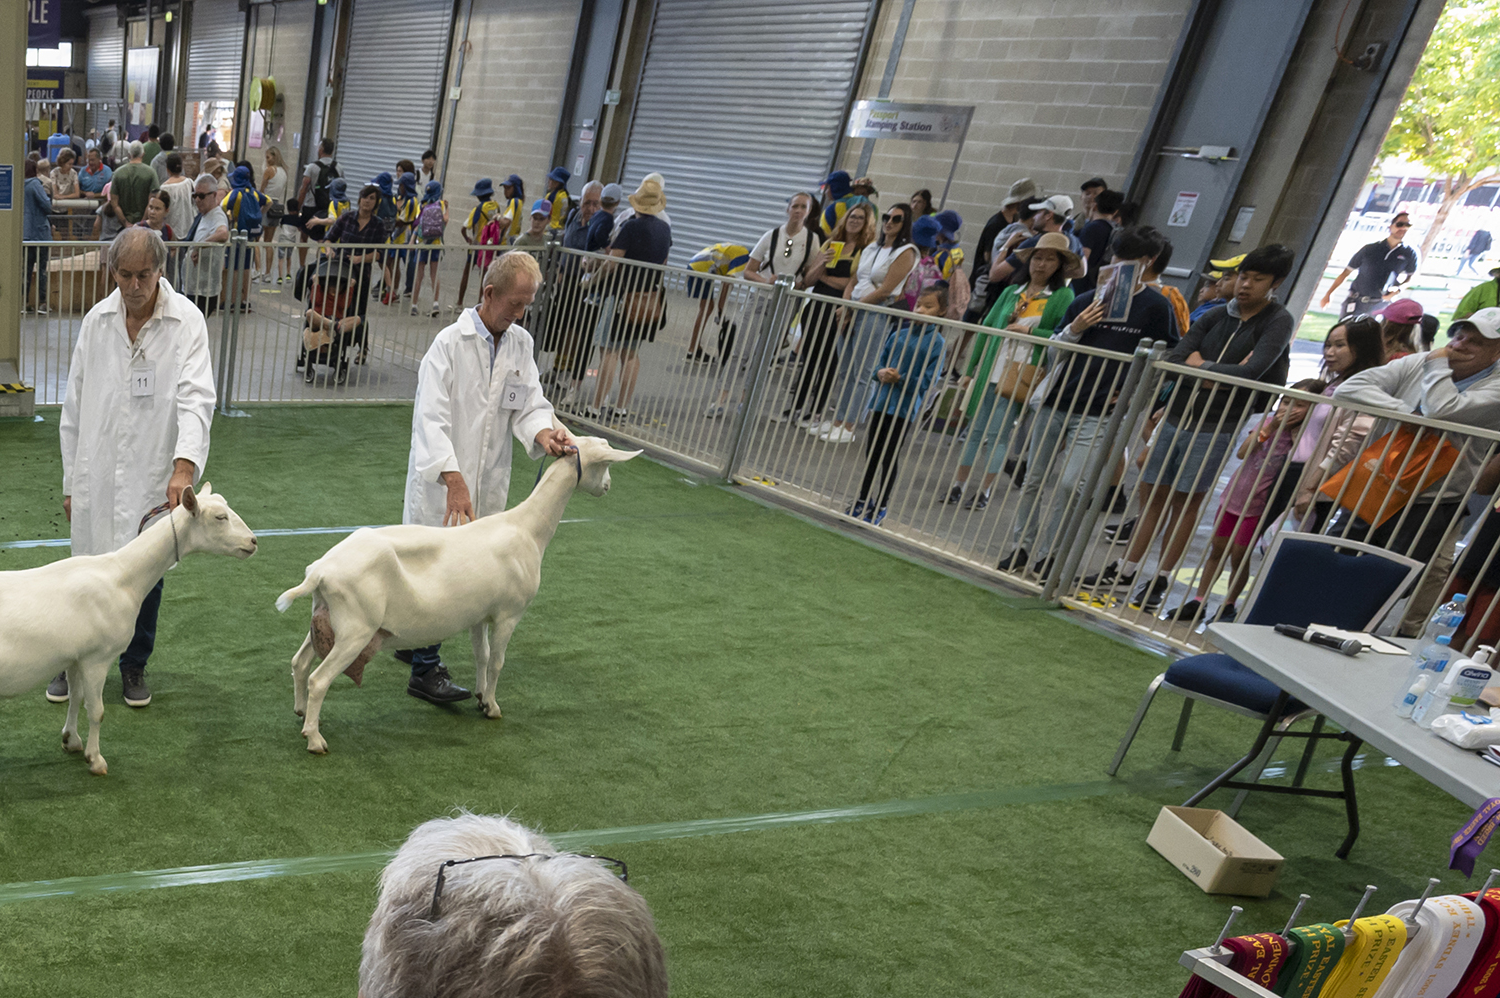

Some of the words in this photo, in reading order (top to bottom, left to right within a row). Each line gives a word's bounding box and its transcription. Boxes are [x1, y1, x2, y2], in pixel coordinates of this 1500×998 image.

[28, 89, 54, 99] PEOPLE
[865, 120, 898, 132] Stamping
[900, 121, 932, 132] Station
[1111, 326, 1142, 334] HILFIGER
[137, 378, 148, 388] 11
[508, 392, 516, 402] 9
[1482, 800, 1500, 814] OYAL
[1477, 822, 1496, 846] BREED
[1360, 930, 1384, 968] PRIZE
[1300, 940, 1321, 980] PRIZE
[1365, 938, 1396, 983] EASTER
[1418, 974, 1436, 996] 2021
[1434, 921, 1462, 970] SYDNEY
[1480, 962, 1498, 984] 2021
